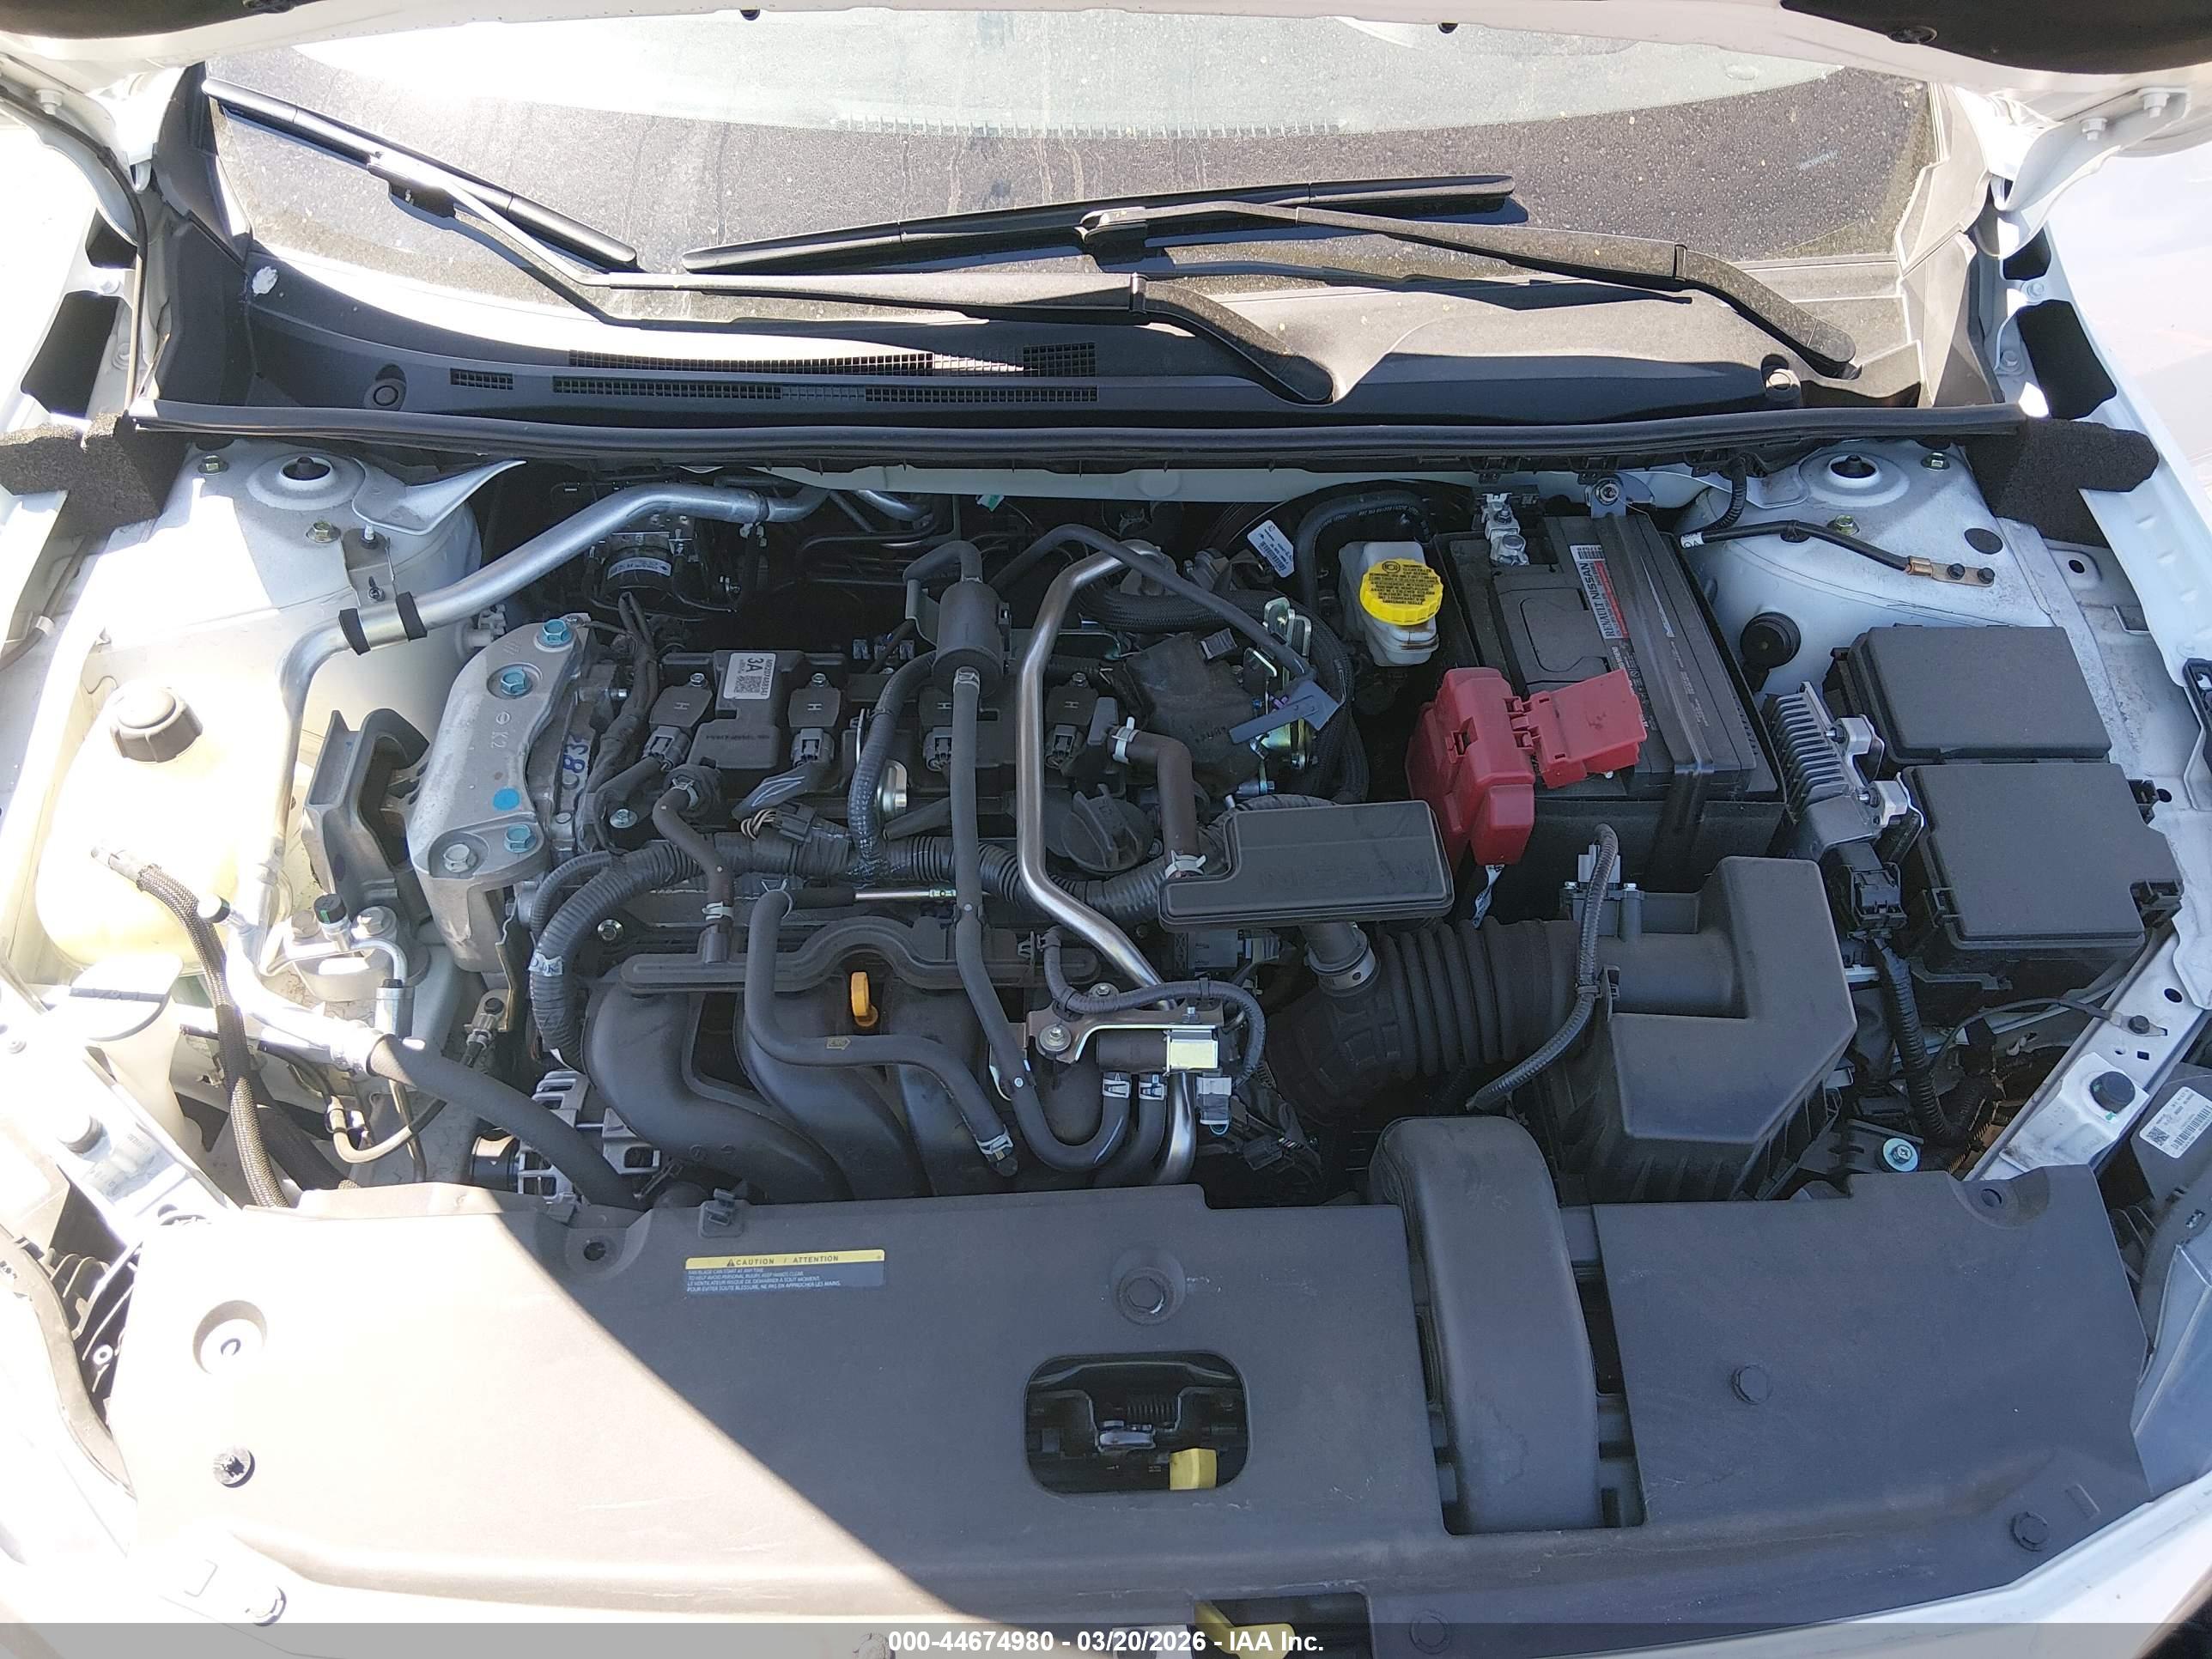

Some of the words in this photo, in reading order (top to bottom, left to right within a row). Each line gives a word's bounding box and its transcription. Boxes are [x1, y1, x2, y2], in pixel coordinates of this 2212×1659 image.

[1578, 562, 1601, 599] NISSAN
[1593, 601, 1615, 637] RENAULT
[746, 658, 764, 672] 3A
